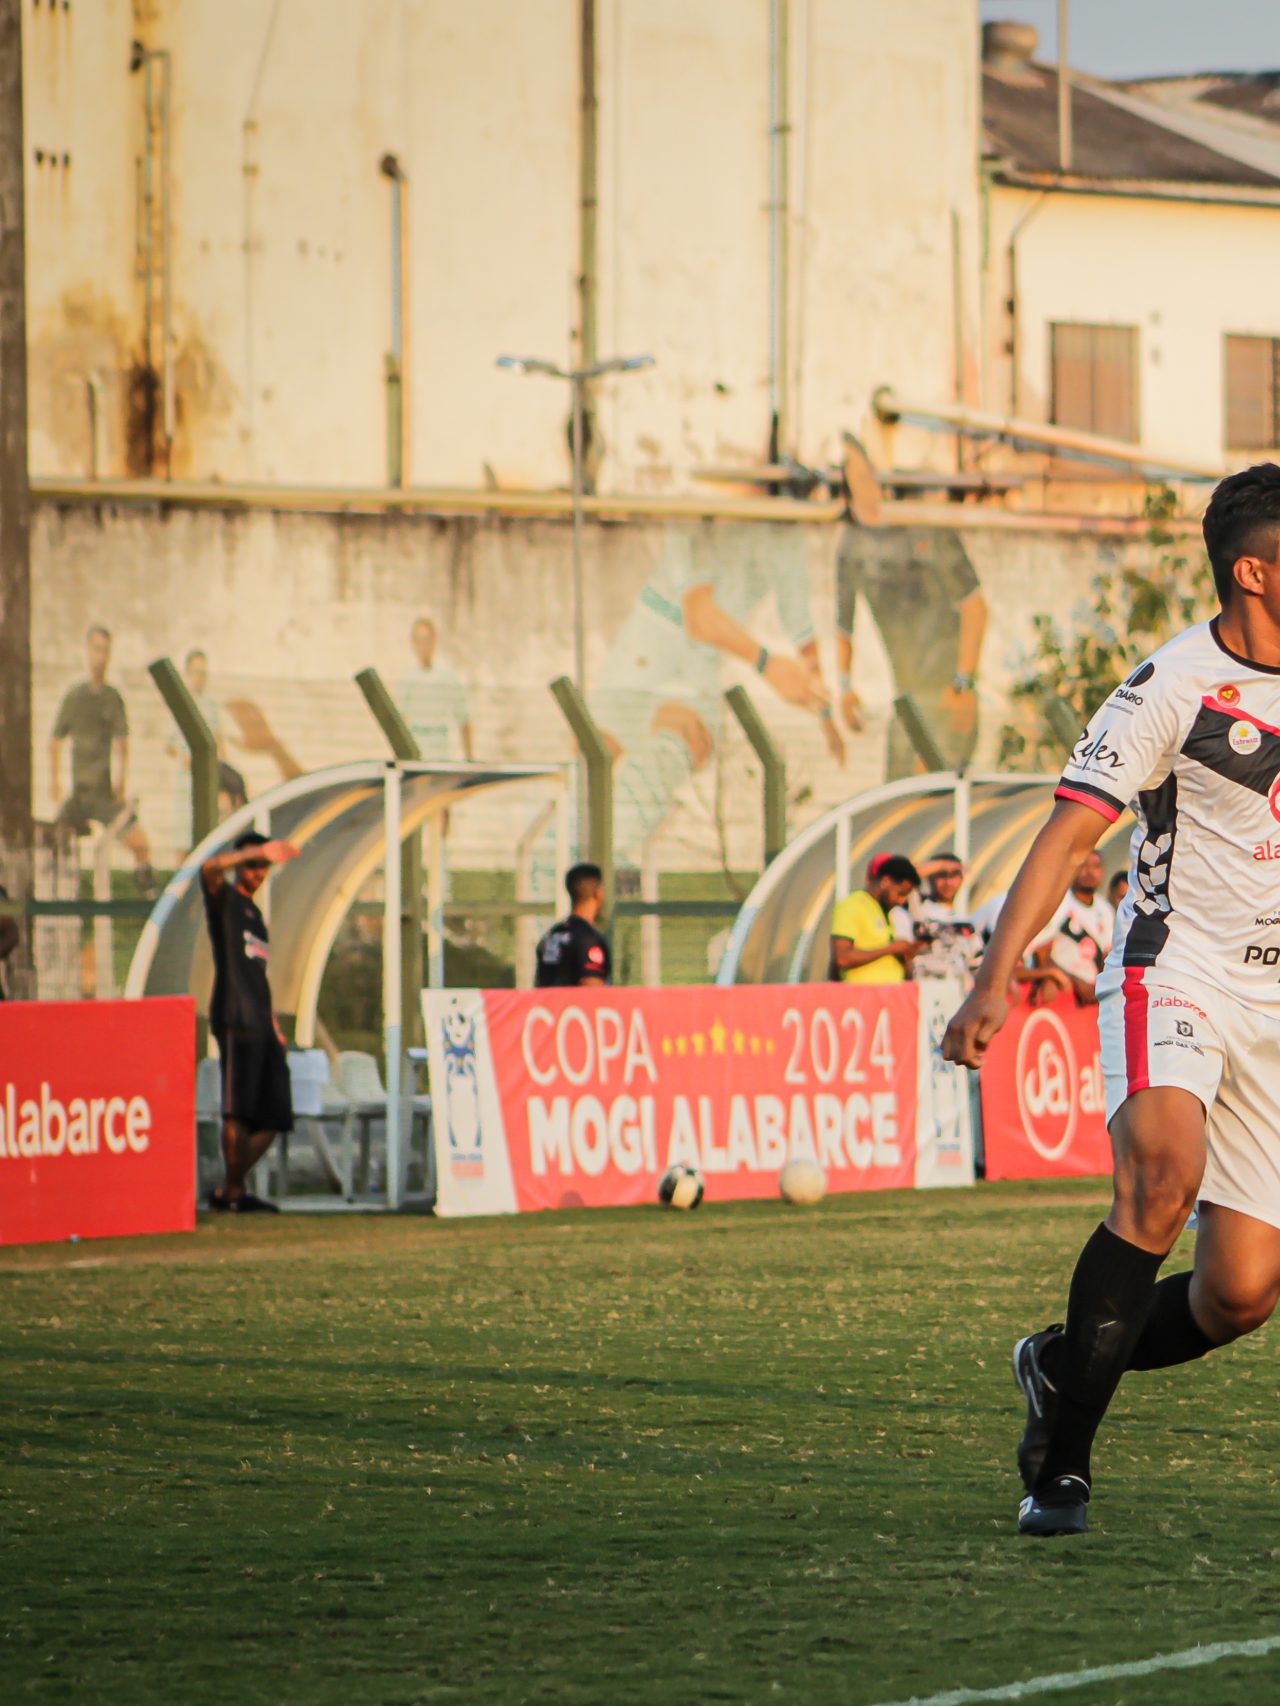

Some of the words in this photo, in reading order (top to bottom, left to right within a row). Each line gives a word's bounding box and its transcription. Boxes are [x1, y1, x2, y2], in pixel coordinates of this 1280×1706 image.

[521, 1005, 659, 1086] COPA
[782, 1007, 895, 1084] 2024
[0, 1081, 151, 1159] labarce
[526, 1094, 659, 1177] MOGI
[667, 1092, 901, 1174] ALABARCE
